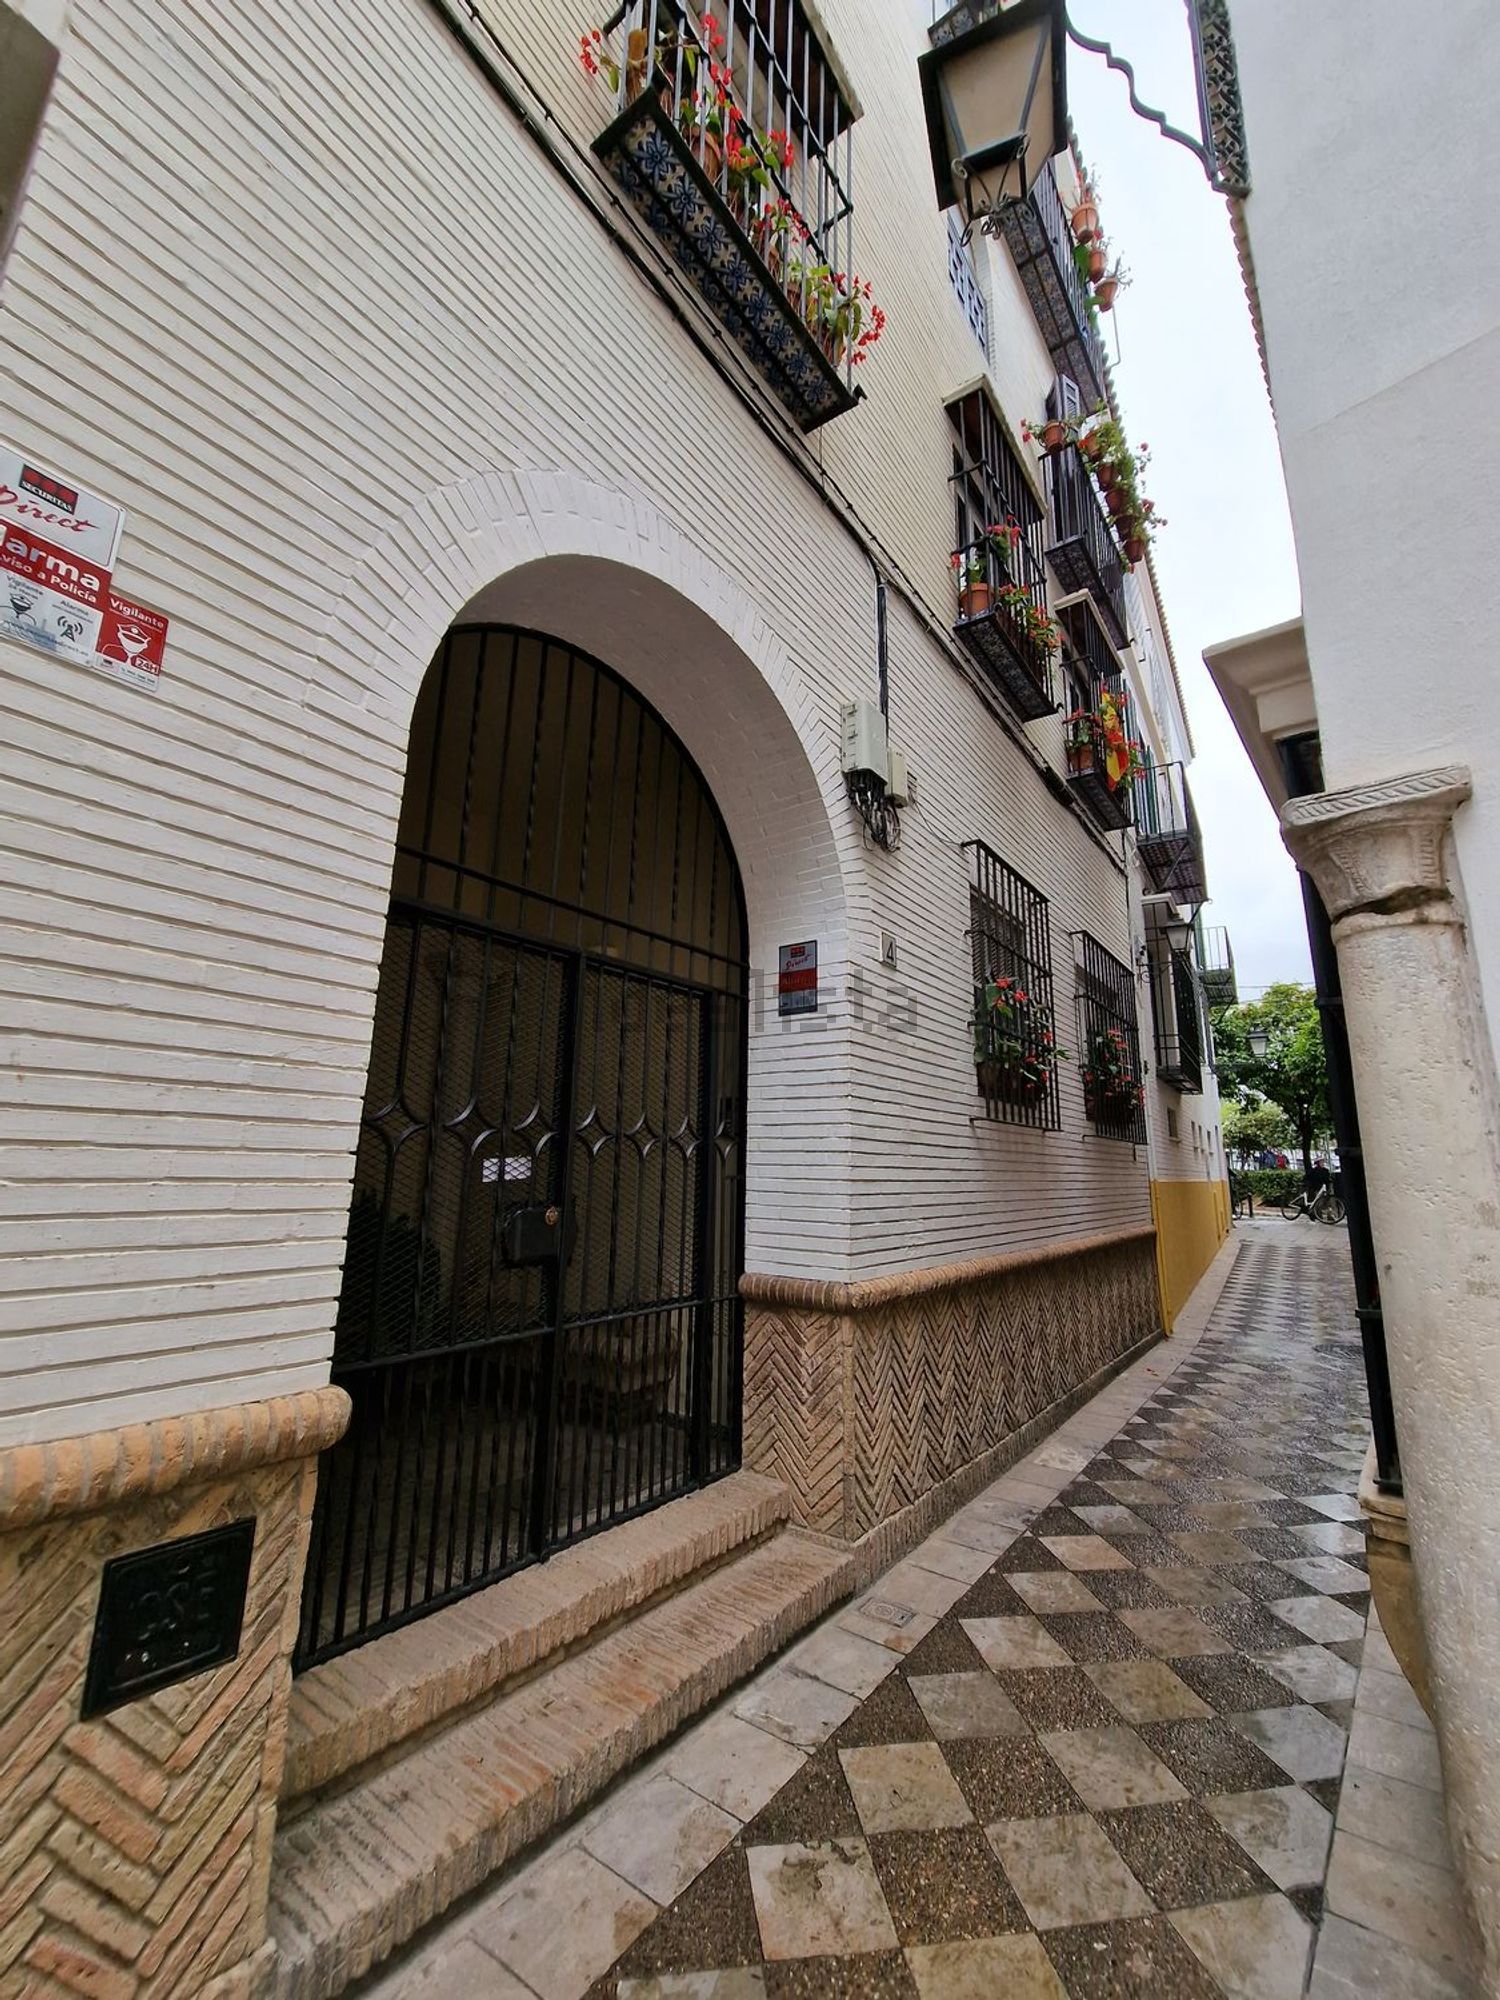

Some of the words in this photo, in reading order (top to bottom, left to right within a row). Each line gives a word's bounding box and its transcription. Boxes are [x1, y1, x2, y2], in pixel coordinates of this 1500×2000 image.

[21, 480, 73, 513] SECURITAS
[0, 523, 100, 592] larma
[0, 553, 33, 574] viso
[37, 571, 46, 580] a
[110, 597, 164, 629] Vigilante
[137, 658, 159, 674] 24H
[886, 941, 895, 962] 4
